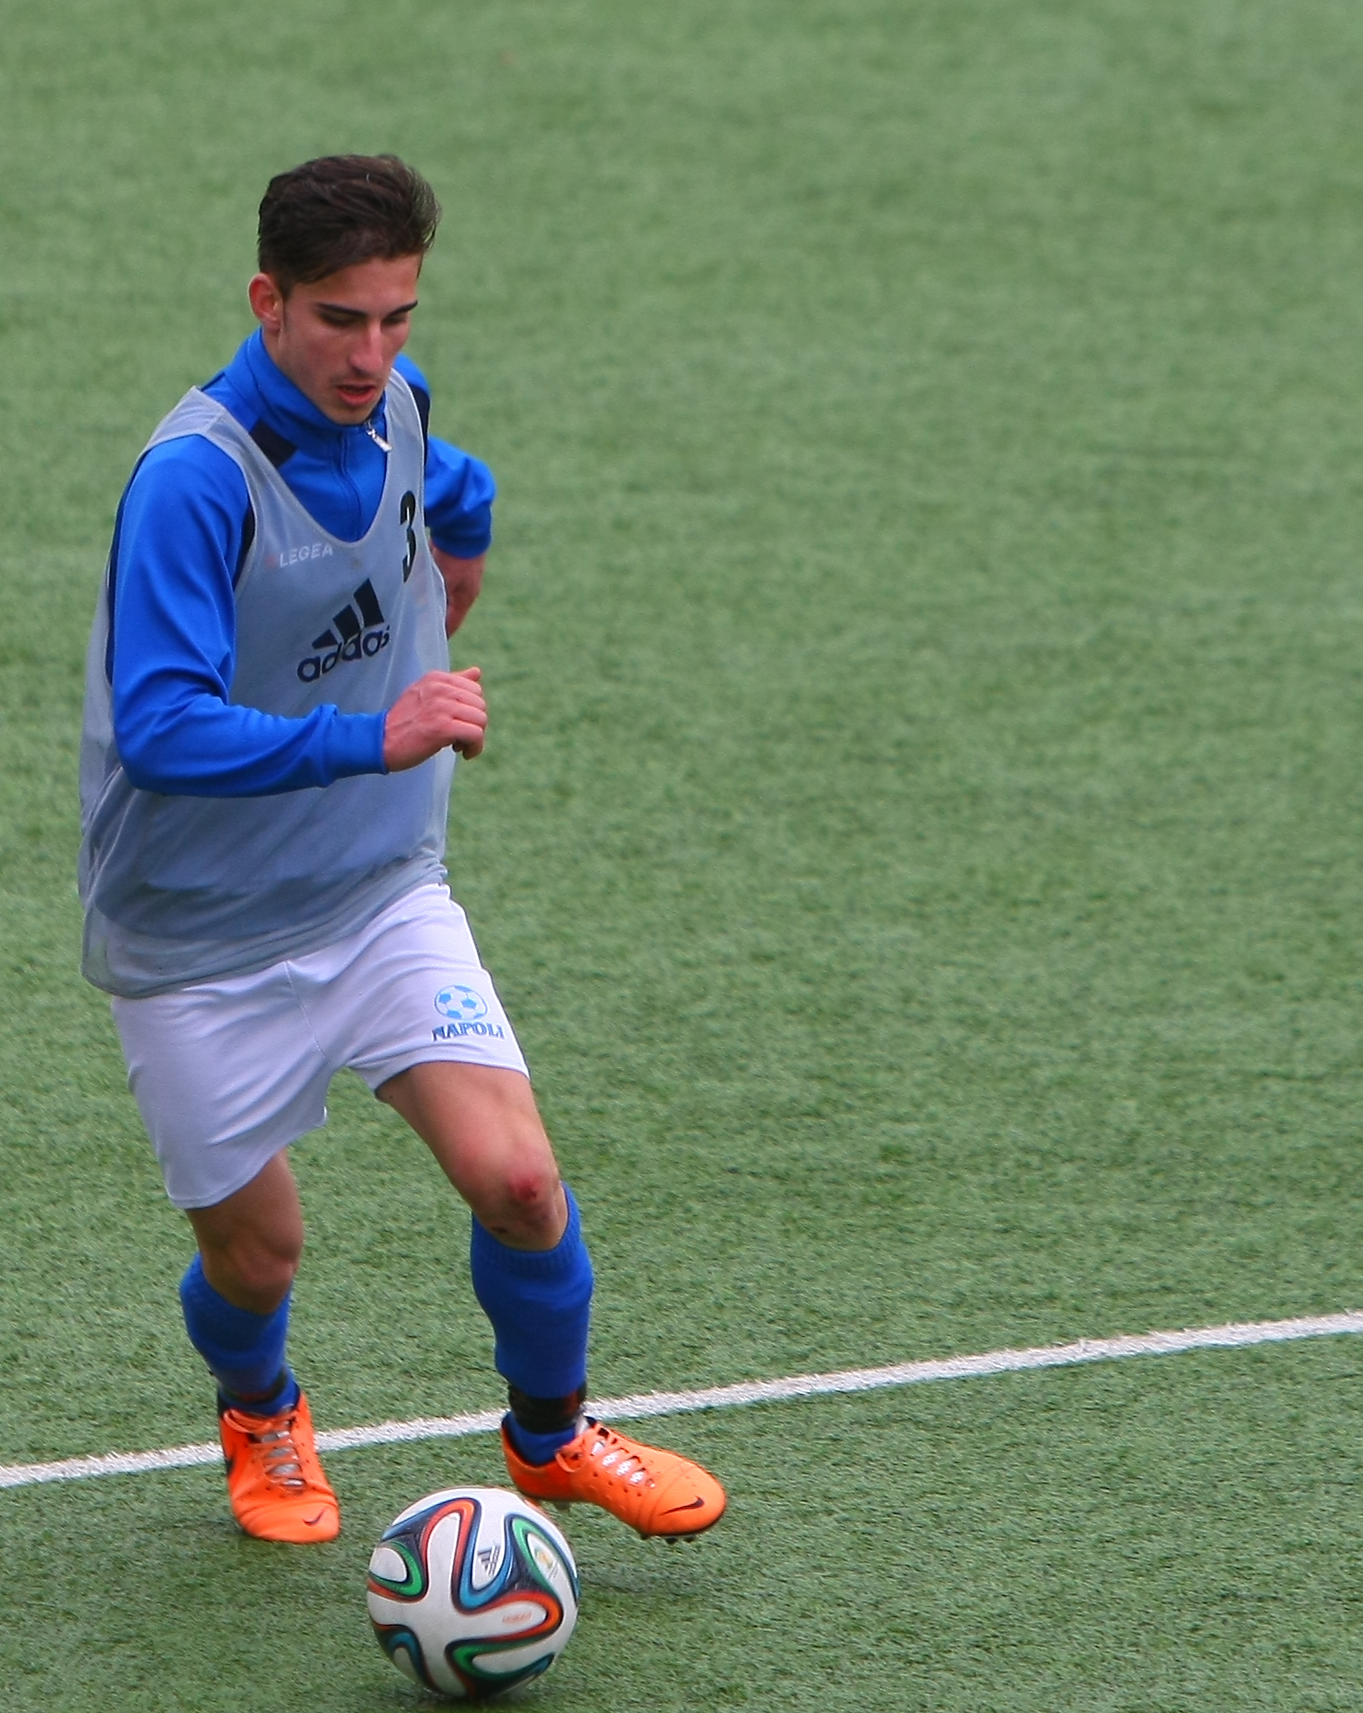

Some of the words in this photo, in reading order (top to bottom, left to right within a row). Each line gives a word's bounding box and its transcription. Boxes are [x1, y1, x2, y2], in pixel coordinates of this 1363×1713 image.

[399, 490, 417, 584] 3
[279, 543, 334, 569] LEGEA
[432, 1022, 505, 1042] NAPOLI
